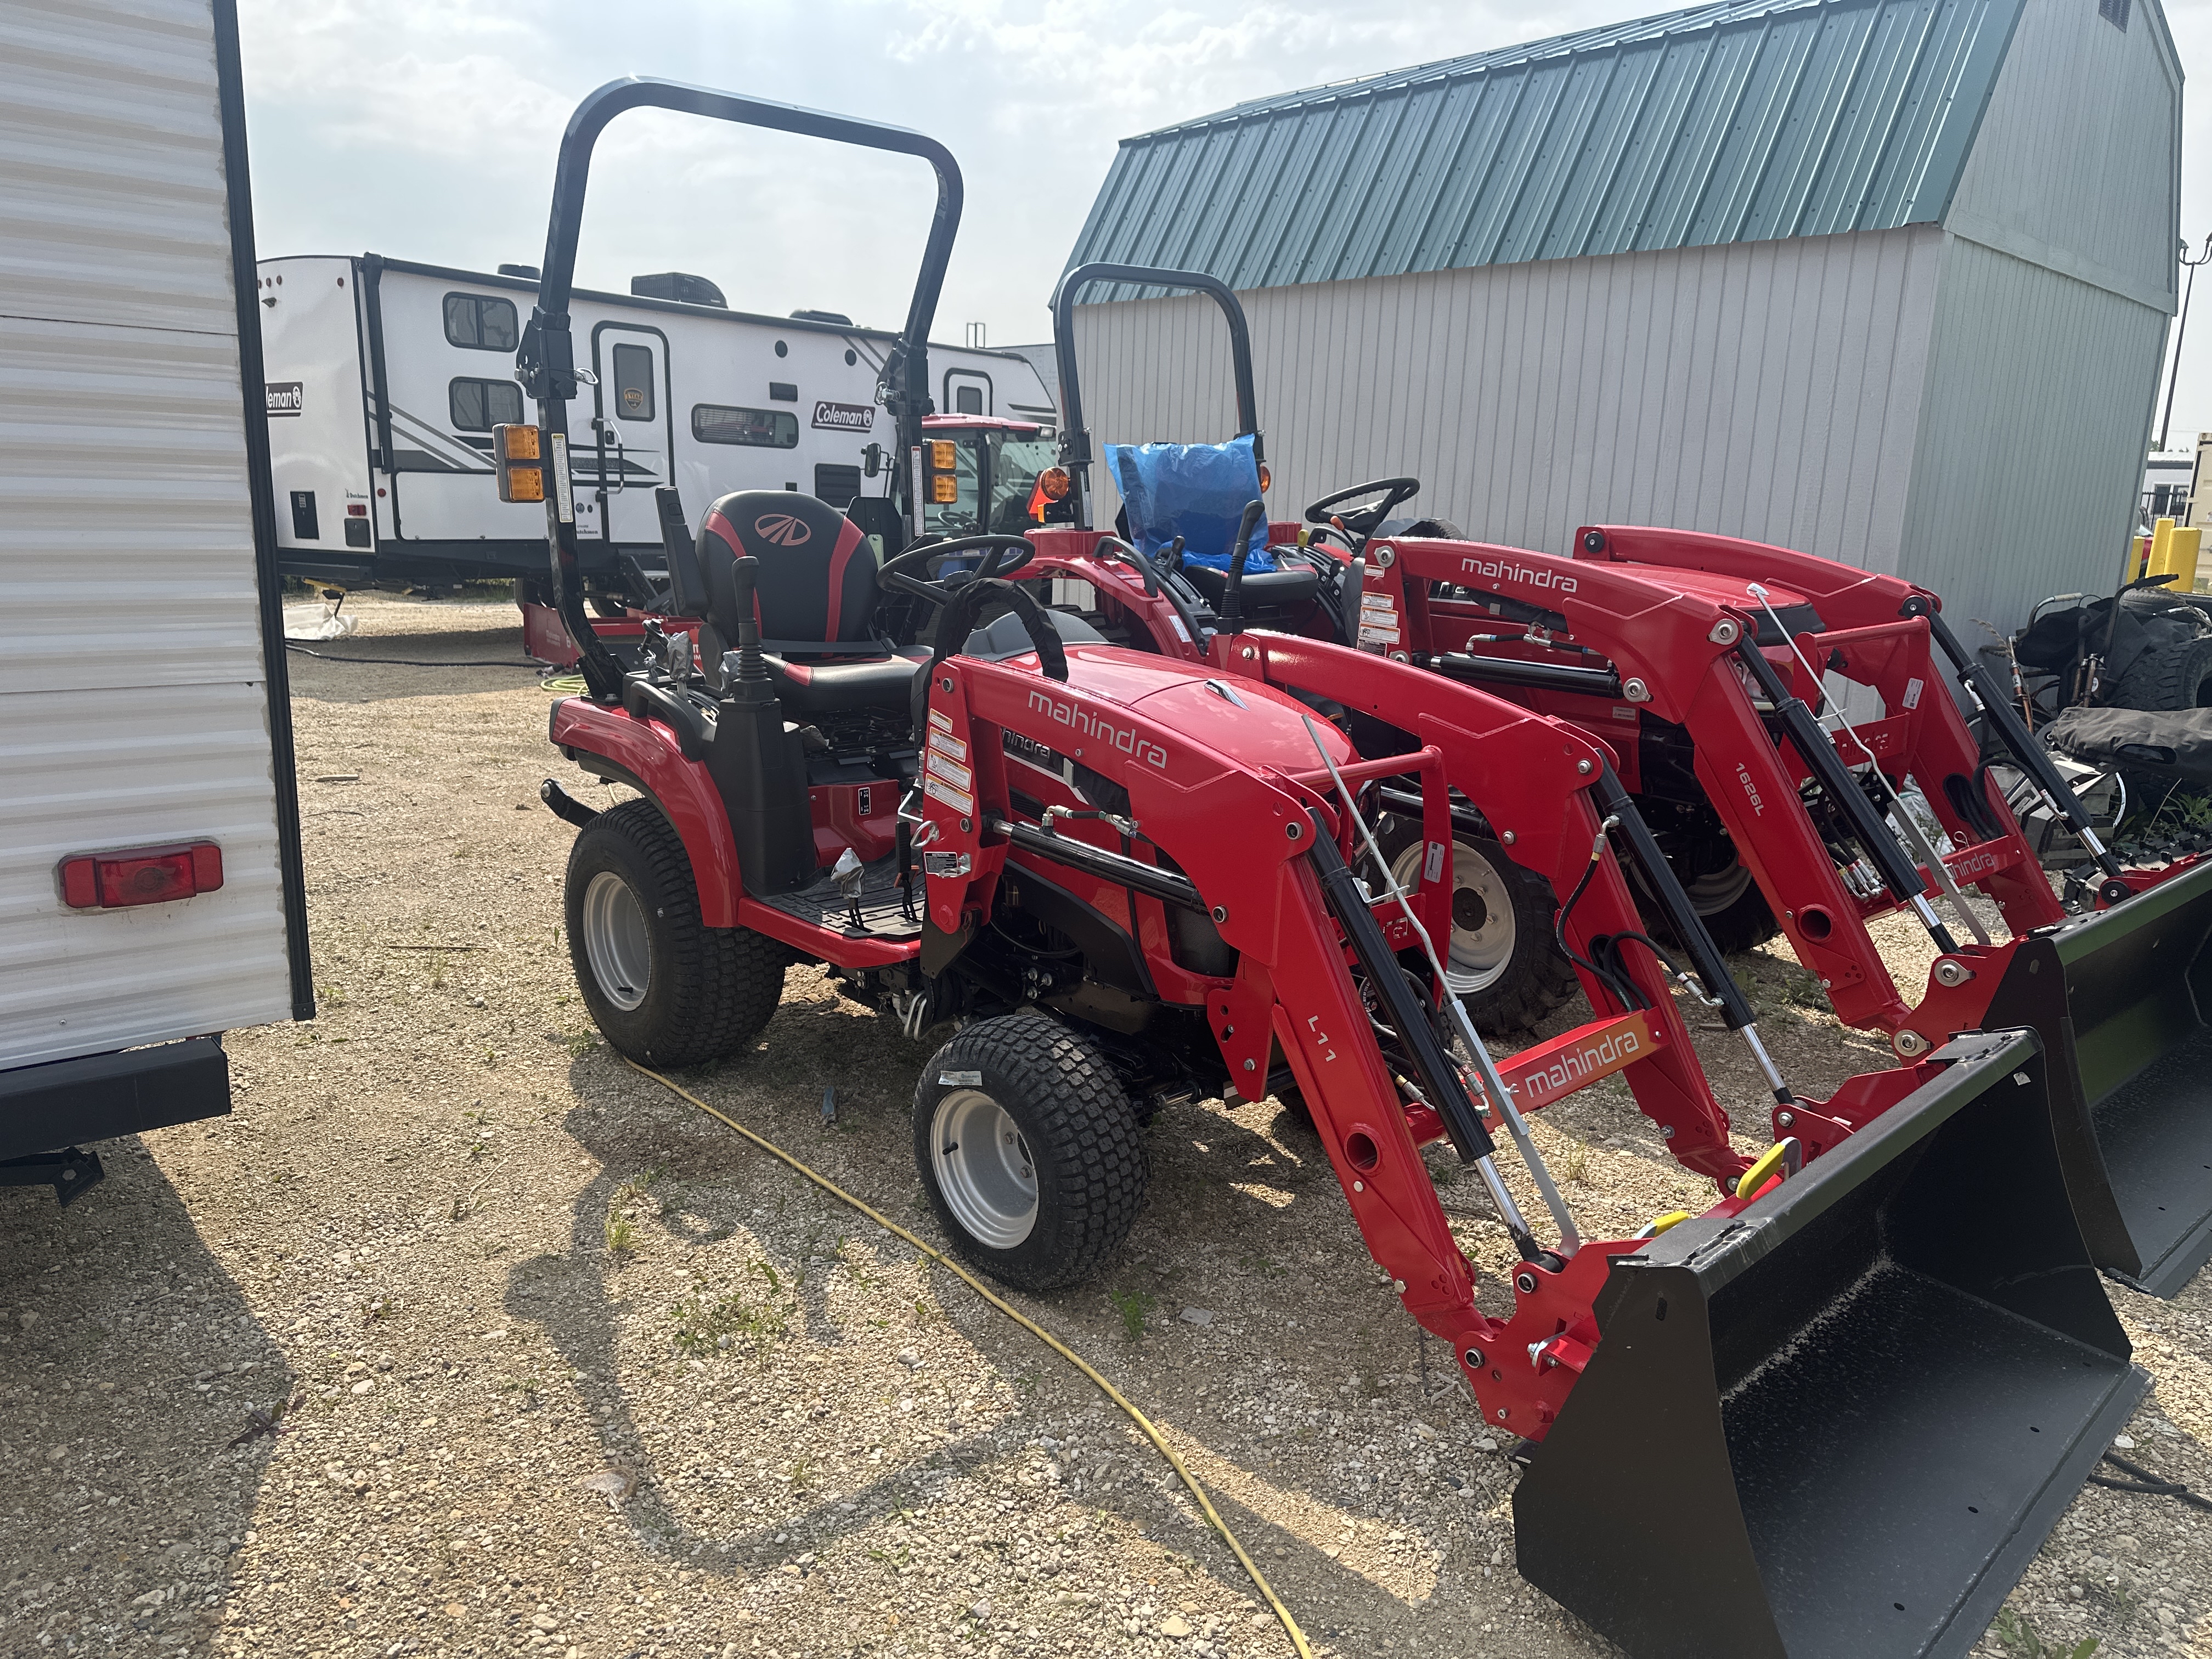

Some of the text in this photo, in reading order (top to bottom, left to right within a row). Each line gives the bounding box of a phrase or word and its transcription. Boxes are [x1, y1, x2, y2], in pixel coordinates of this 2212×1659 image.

[266, 386, 292, 408] leman
[816, 403, 862, 425] Coleman
[1462, 558, 1578, 593] mahindra
[1000, 727, 1051, 759] hindra
[1028, 690, 1167, 769] mahindra
[1736, 763, 1764, 817] 1626L
[1948, 853, 1995, 880] hindra
[1525, 1031, 1639, 1098] mahindra
